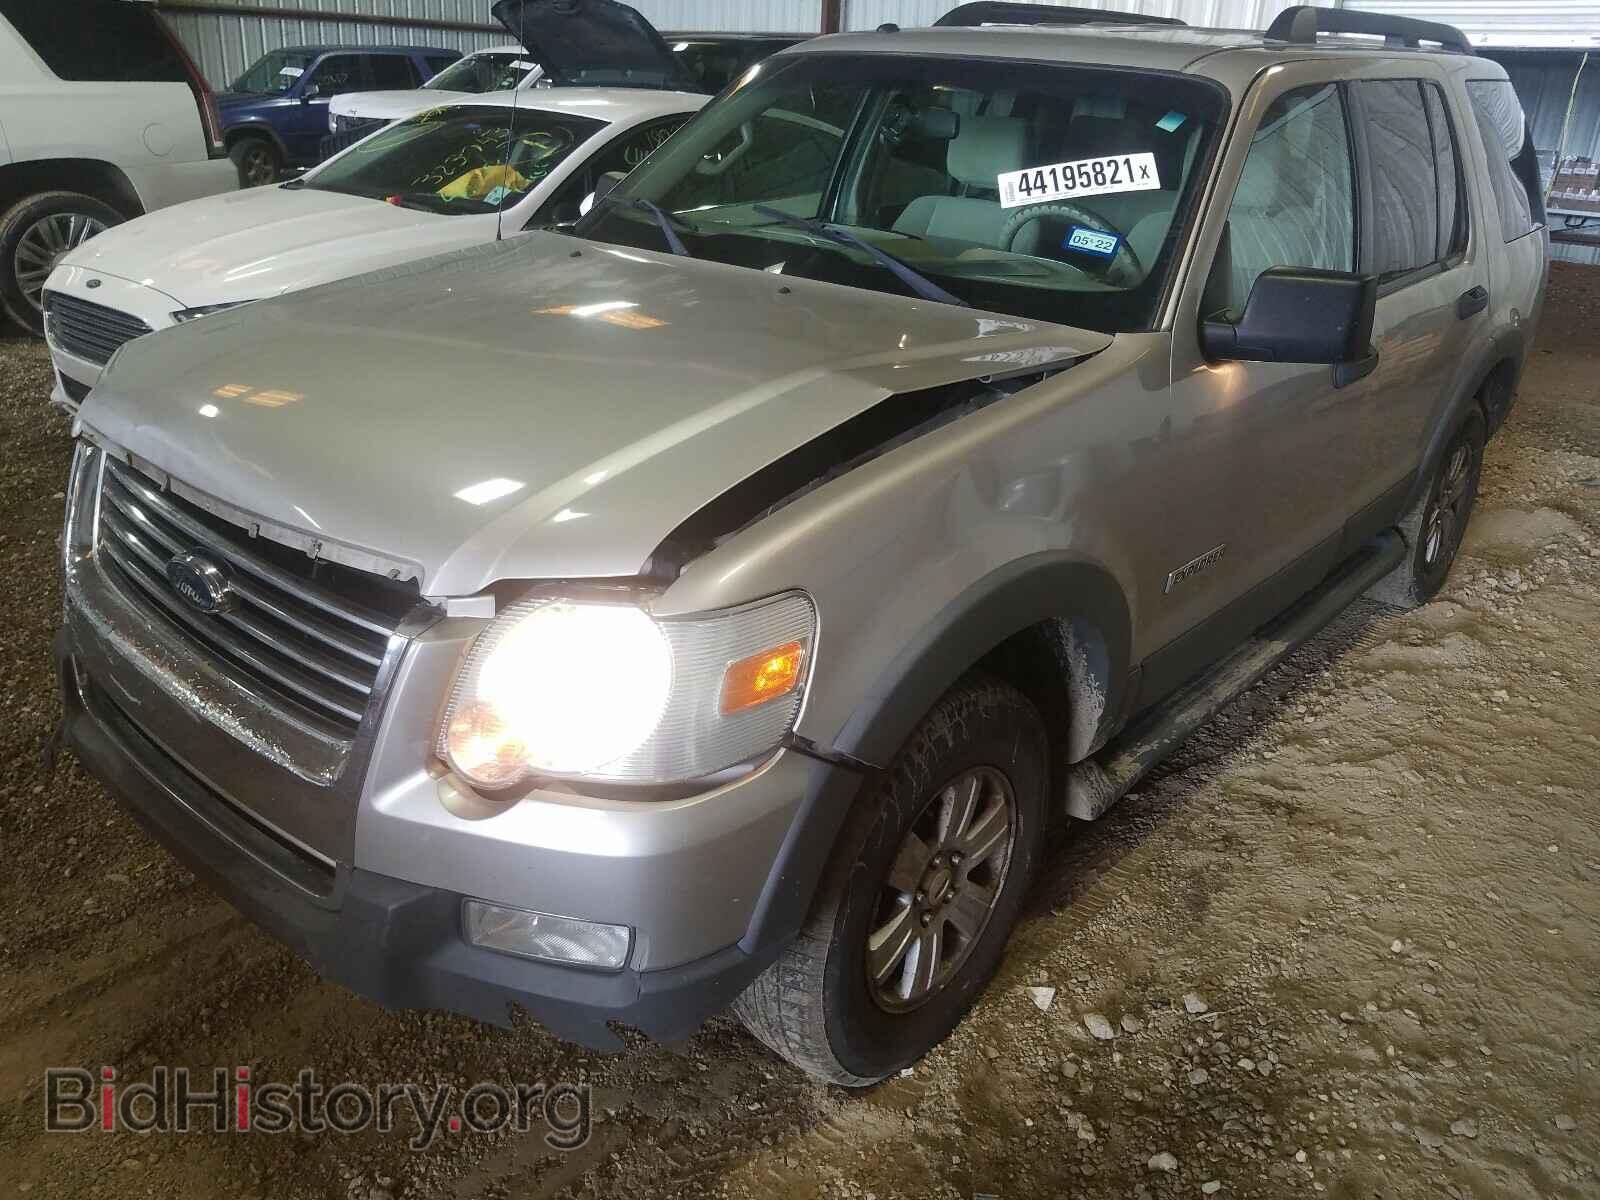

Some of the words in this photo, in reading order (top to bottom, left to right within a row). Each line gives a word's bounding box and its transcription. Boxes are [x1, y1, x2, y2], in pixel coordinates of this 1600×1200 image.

[1018, 157, 1135, 197] 44195821
[1072, 235, 1089, 246] 05
[1095, 239, 1113, 251] 22
